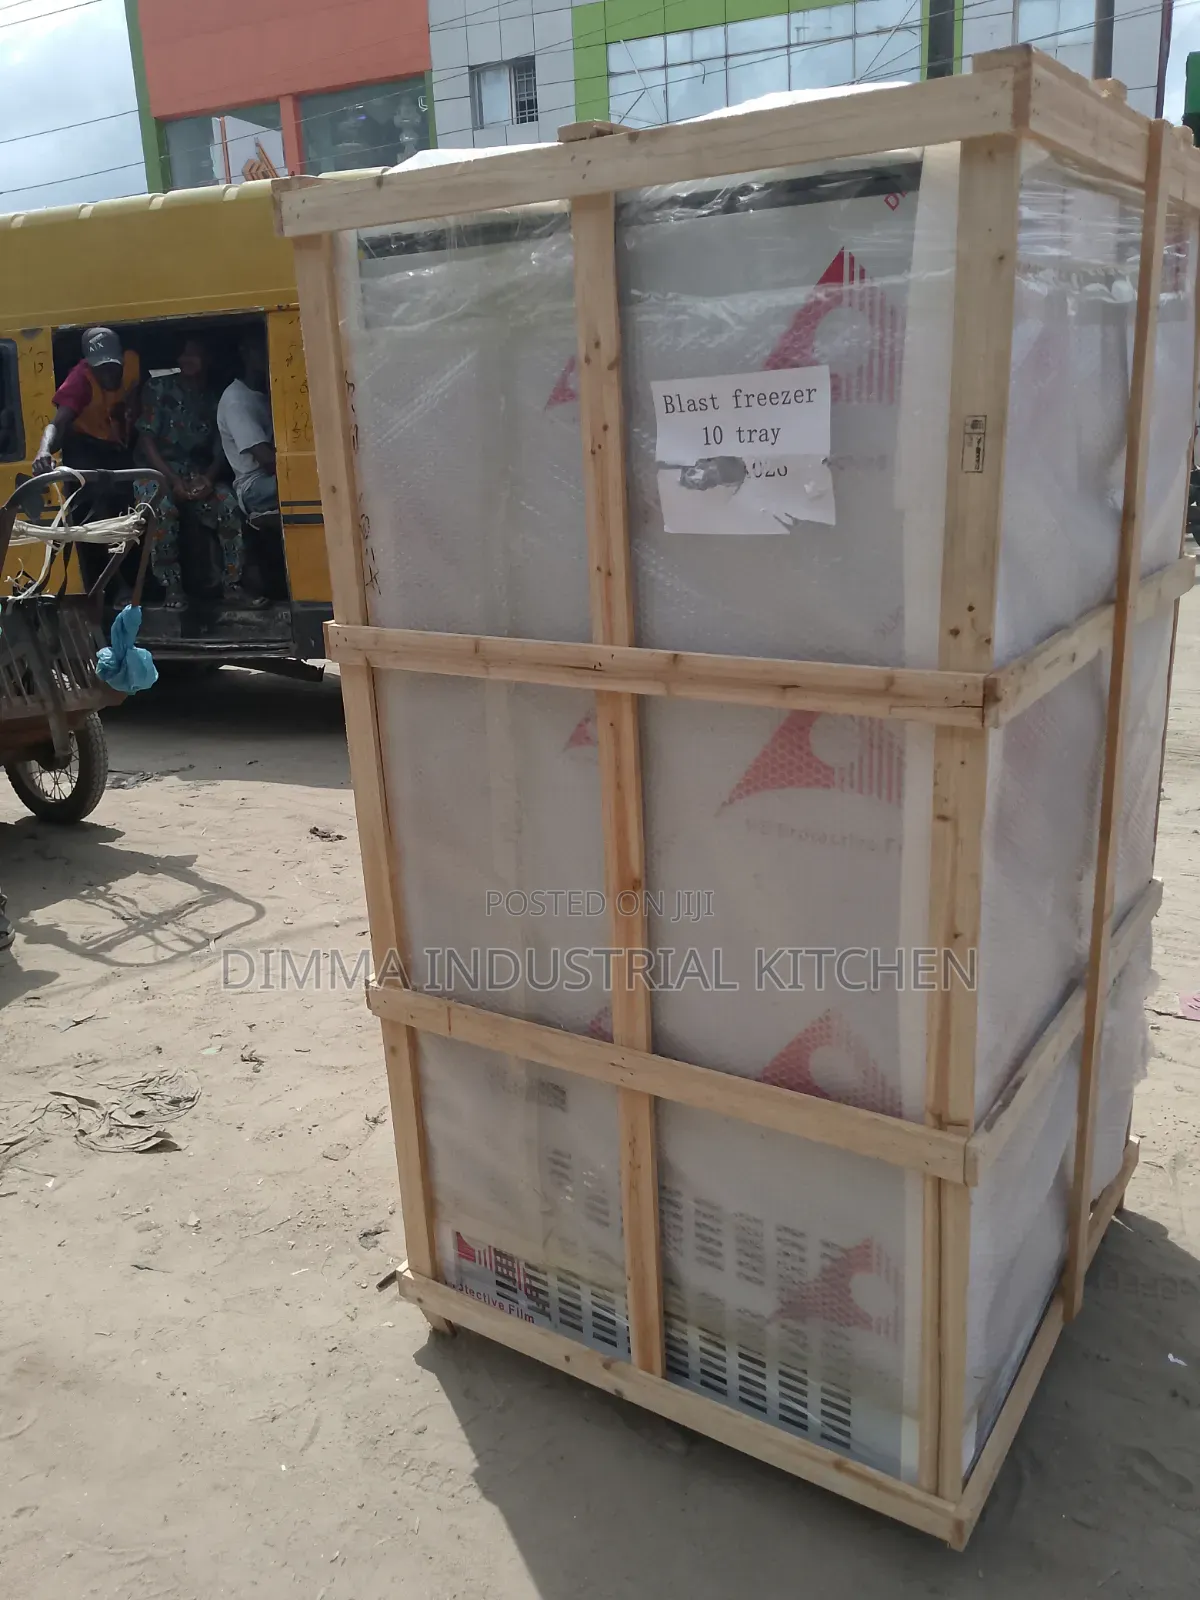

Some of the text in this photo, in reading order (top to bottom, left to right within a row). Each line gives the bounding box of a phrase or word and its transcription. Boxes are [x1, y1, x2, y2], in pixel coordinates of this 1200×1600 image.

[662, 387, 818, 414] Blast freezer
[702, 425, 782, 446] 10 tray
